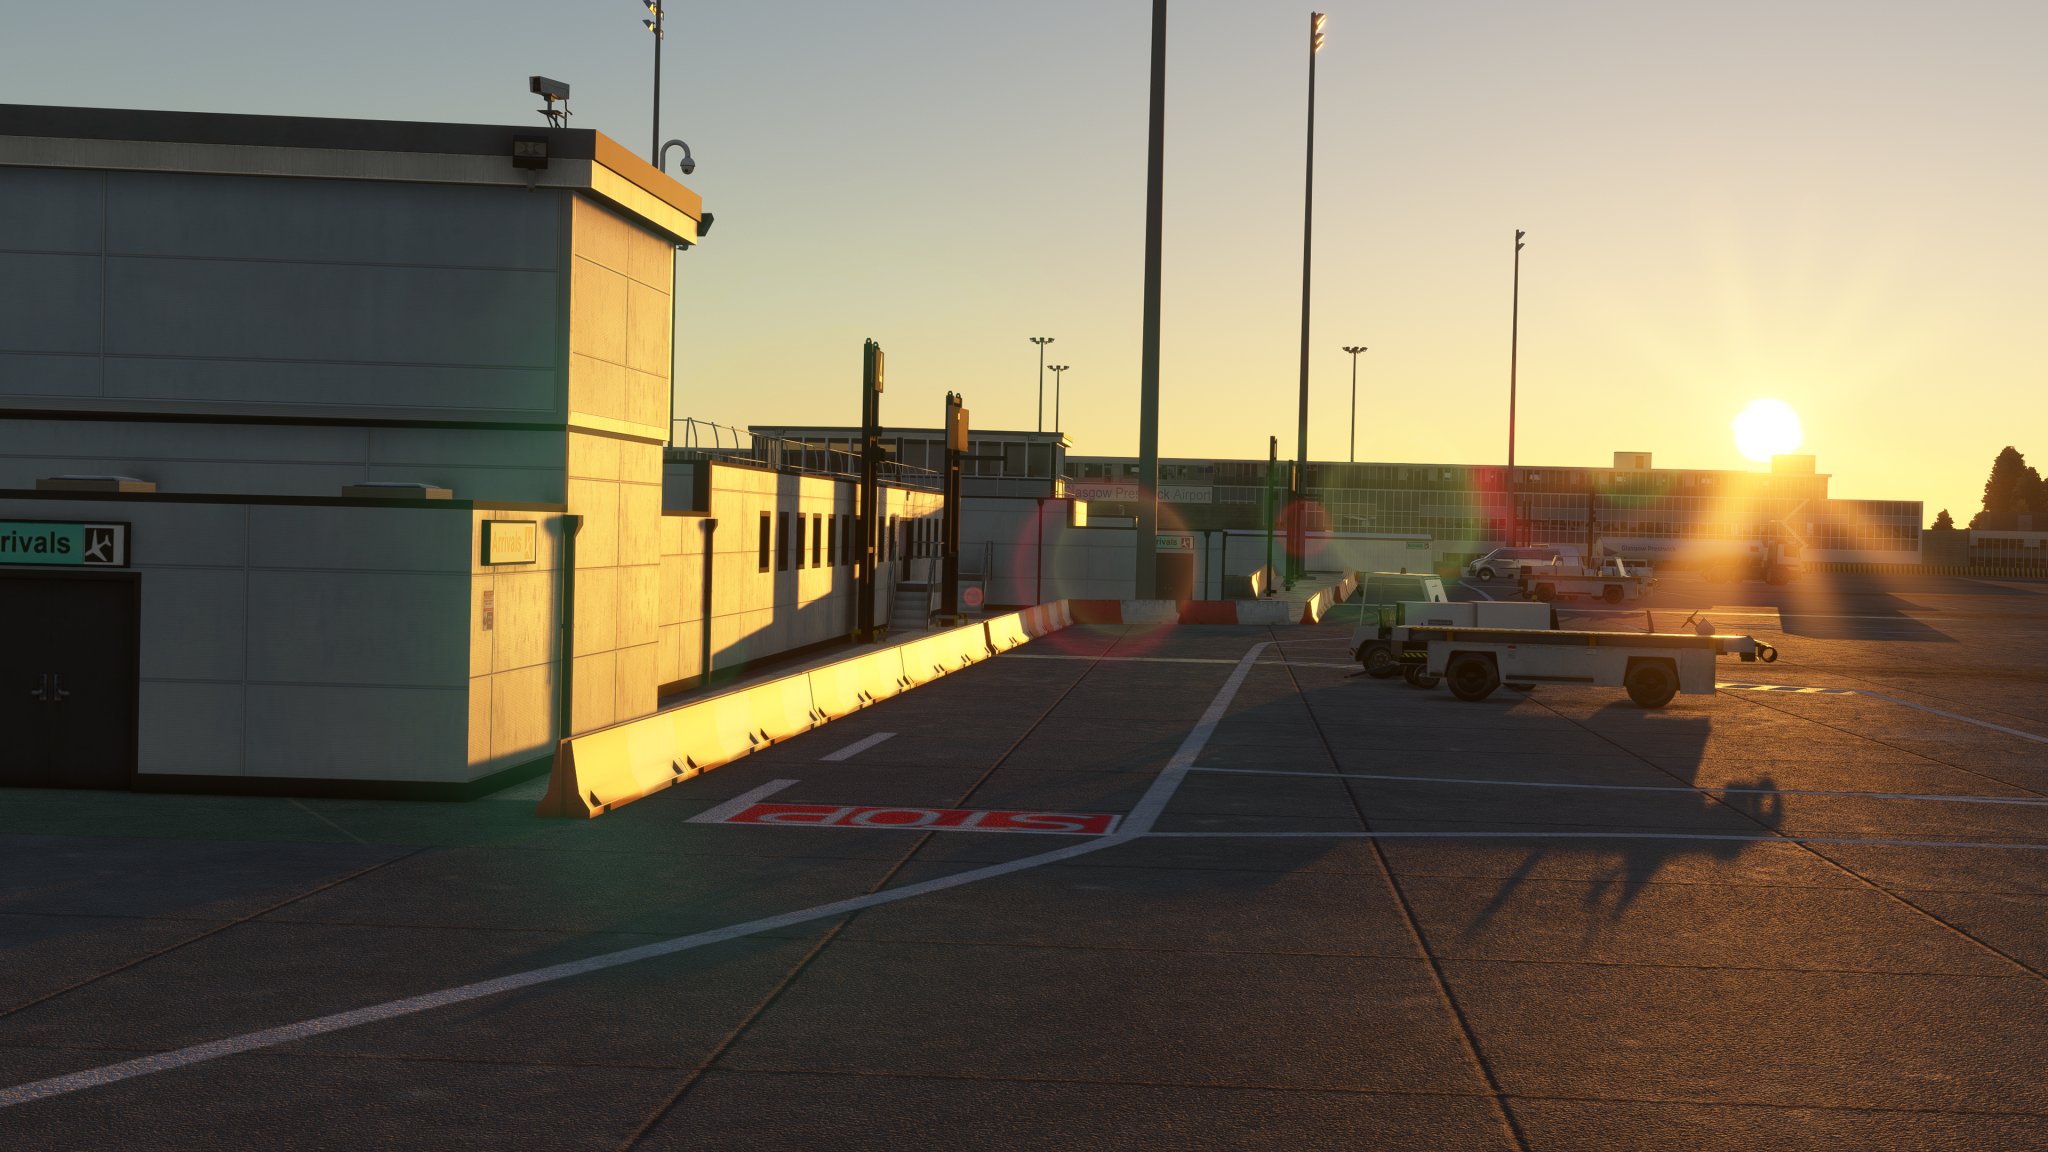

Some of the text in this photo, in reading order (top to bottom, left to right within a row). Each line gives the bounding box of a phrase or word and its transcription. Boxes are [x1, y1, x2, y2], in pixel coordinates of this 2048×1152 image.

[1173, 488, 1211, 503] Airport
[492, 528, 521, 553] Arrivals
[757, 807, 1096, 832] STOP
